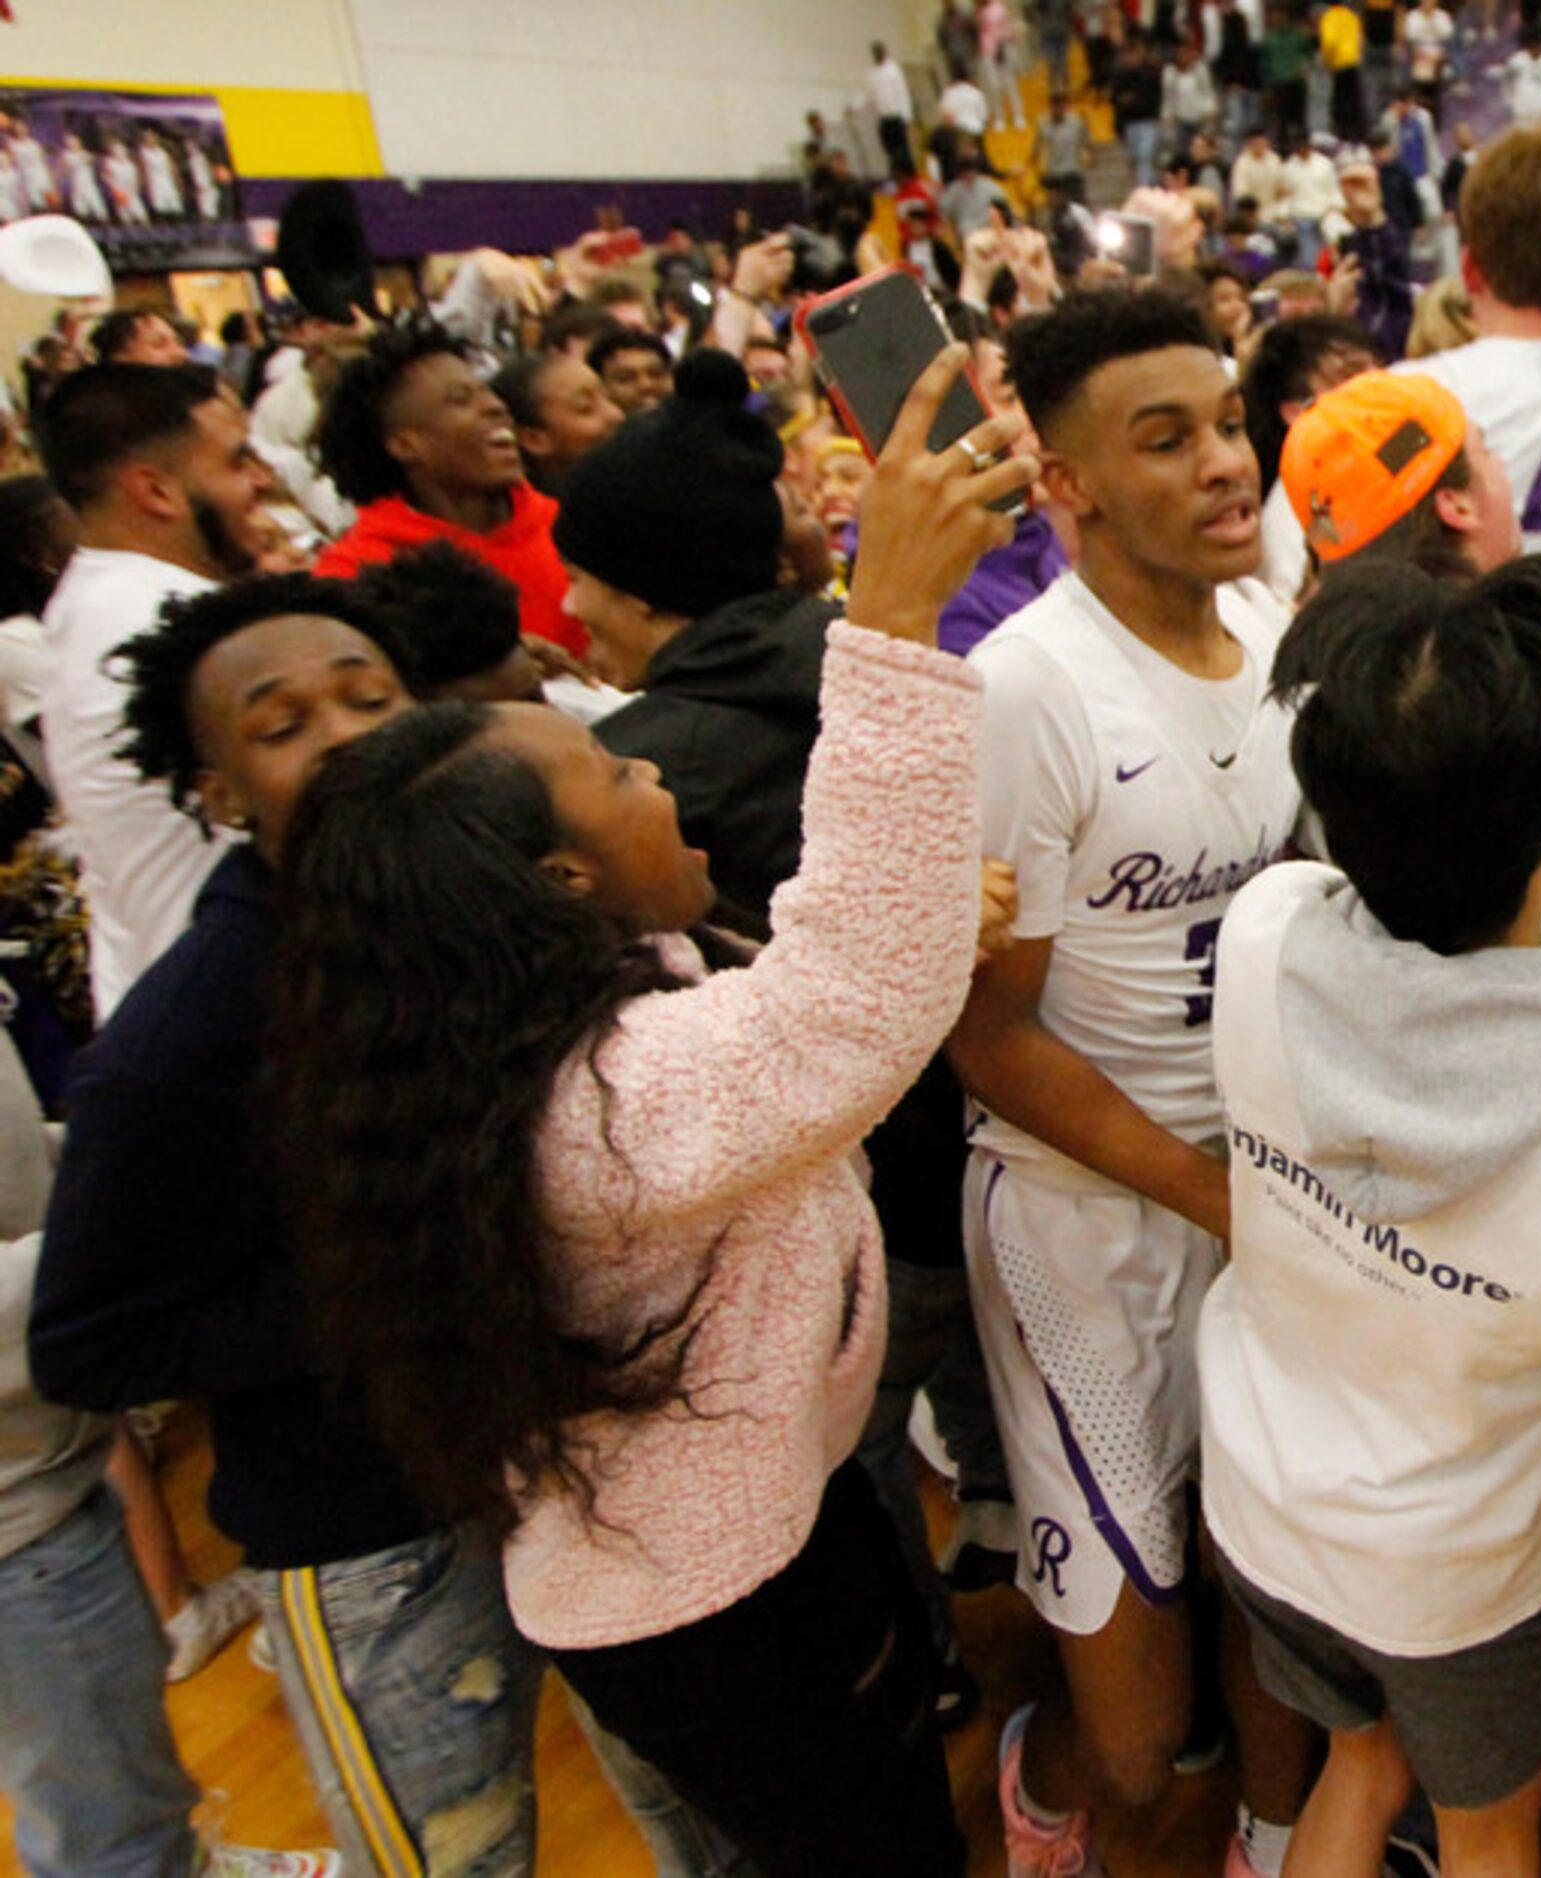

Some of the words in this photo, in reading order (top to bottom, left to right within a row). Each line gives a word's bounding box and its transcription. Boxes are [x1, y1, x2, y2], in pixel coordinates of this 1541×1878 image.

[1227, 1120, 1355, 1230] njamin
[1362, 1223, 1514, 1304] Moore
[1031, 1516, 1072, 1598] R
